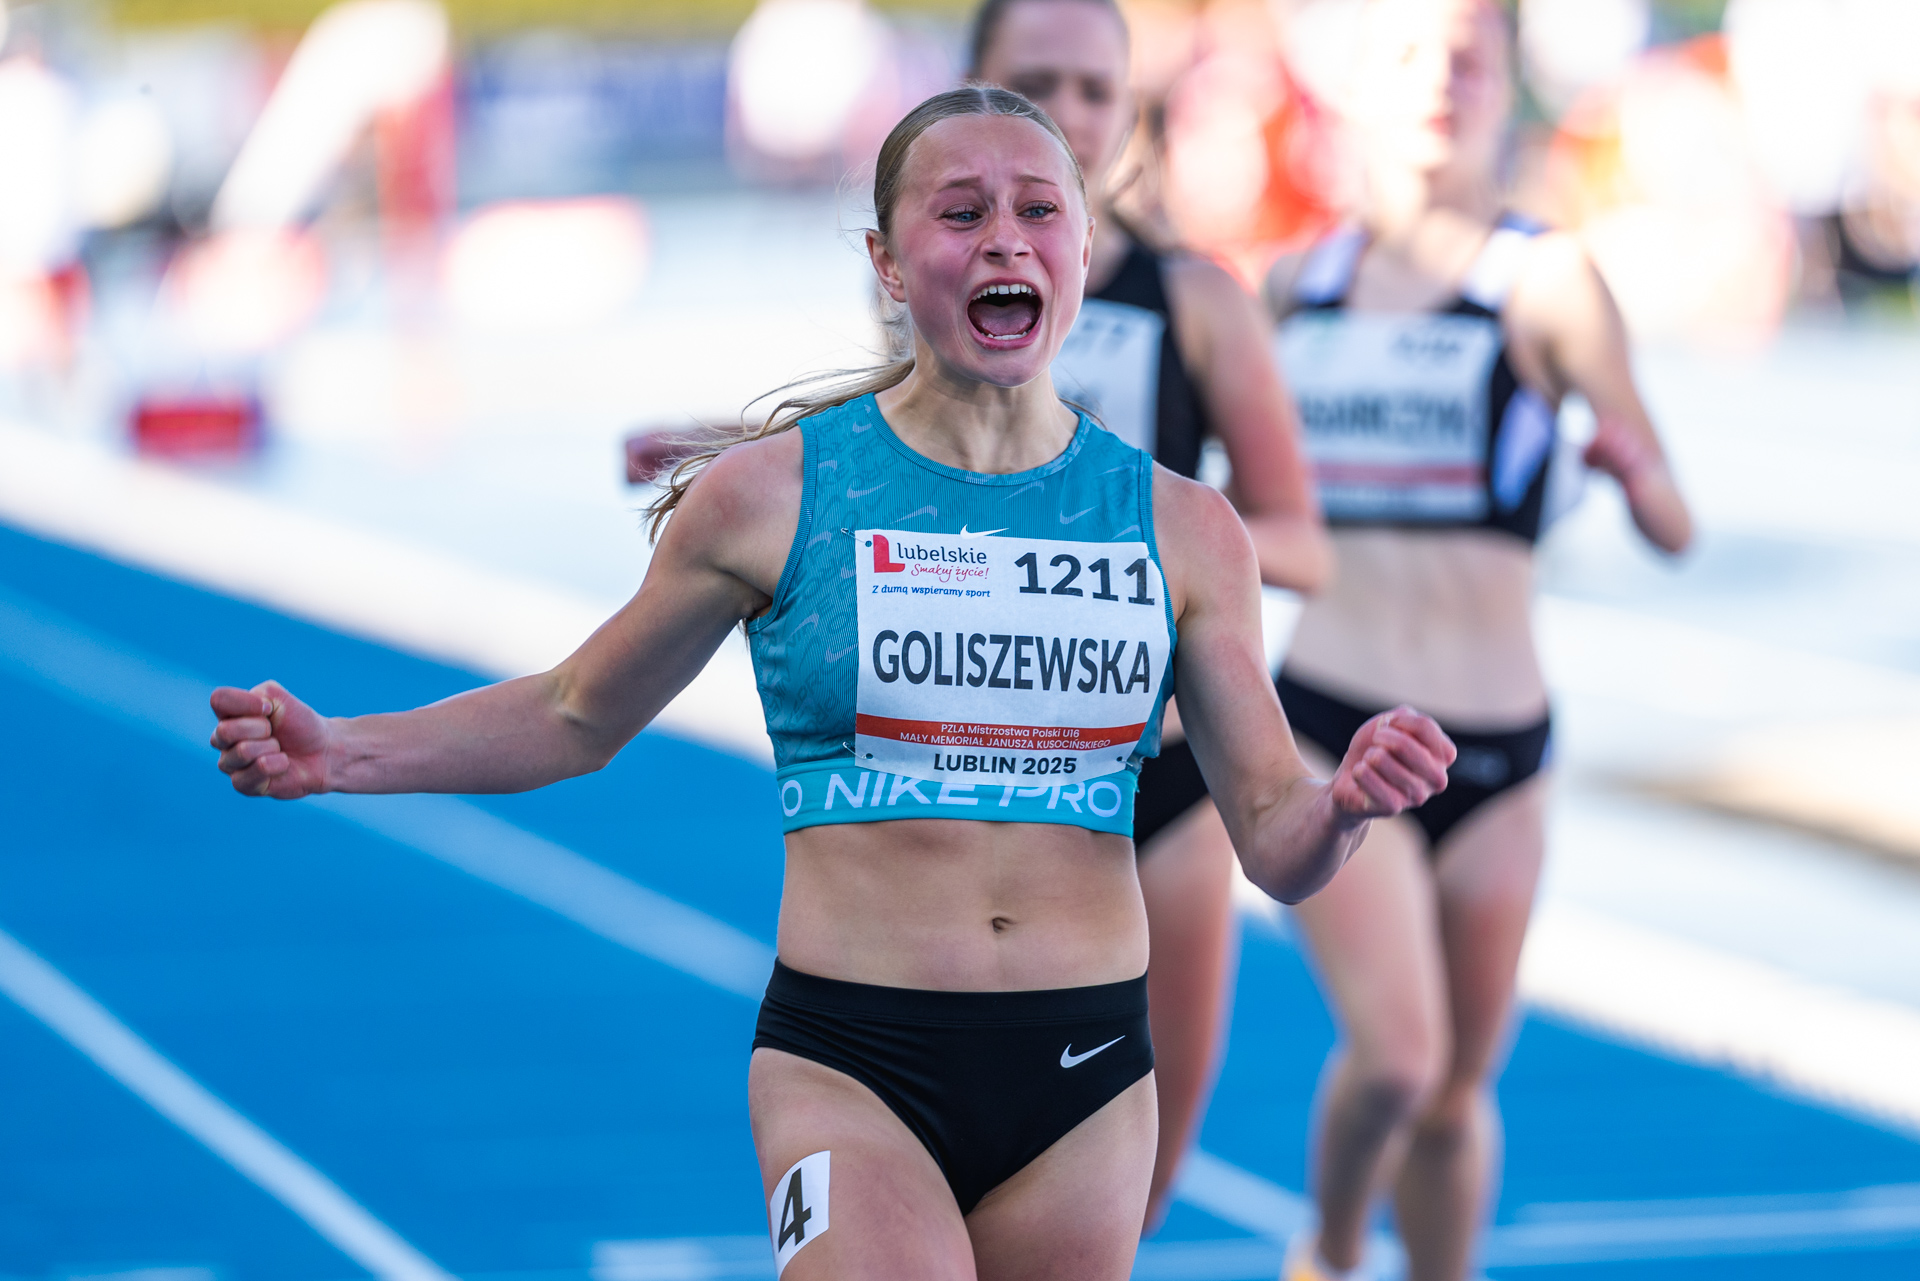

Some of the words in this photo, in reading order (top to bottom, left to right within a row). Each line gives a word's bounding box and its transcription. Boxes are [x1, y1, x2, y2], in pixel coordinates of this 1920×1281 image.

[897, 543, 987, 564] lubelskie
[911, 564, 953, 583] Smakuj
[956, 566, 989, 582] życie!
[1014, 552, 1155, 606] 1211
[872, 585, 879, 594] Z
[881, 585, 908, 595] dumą
[911, 587, 963, 597] wspieramy
[965, 589, 991, 598] sport
[872, 630, 1150, 695] GOLISZEWSKA
[900, 732, 928, 743] MAŁY
[930, 735, 984, 746] MEMORIAŁ
[986, 738, 1034, 748] JANUSZA
[1036, 739, 1111, 750] KUSOCIŃSKIEGO
[941, 724, 965, 734] PZLA
[967, 725, 1030, 737] Mistrzostwa
[1032, 728, 1061, 738] Polski
[1062, 729, 1080, 738] U16
[934, 753, 1017, 774] LUBLIN
[1021, 757, 1077, 775] 2025
[824, 771, 979, 811] NIKE
[998, 780, 1122, 818] PRO
[778, 1166, 812, 1254] 4
